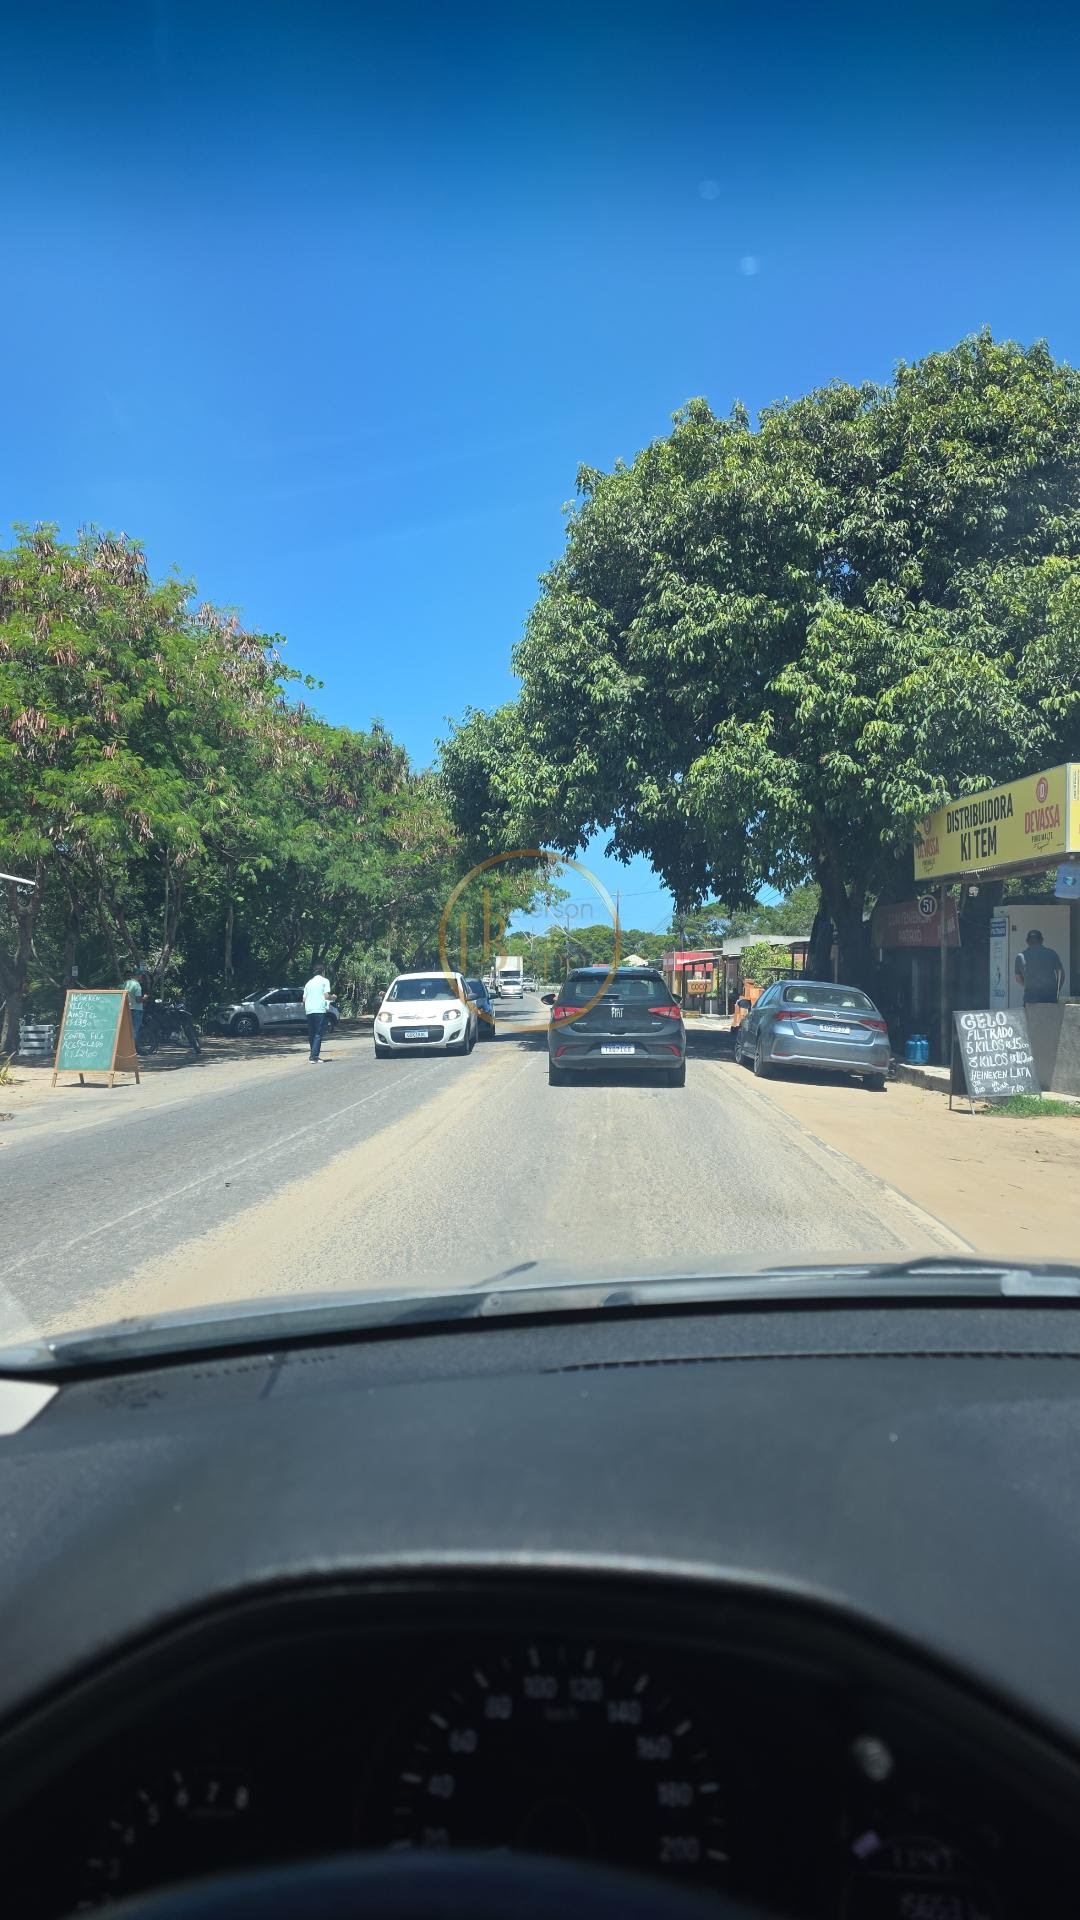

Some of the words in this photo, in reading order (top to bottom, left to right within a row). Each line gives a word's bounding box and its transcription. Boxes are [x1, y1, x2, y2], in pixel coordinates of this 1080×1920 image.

[946, 793, 1014, 834] DISTRIBUIDORA
[1024, 804, 1061, 835] DEVASSA
[961, 833, 971, 862] KI
[974, 825, 997, 859] TEM
[923, 900, 933, 913] 51
[611, 1007, 624, 1018] FIAT
[960, 1011, 1008, 1030] GELO
[967, 1026, 1014, 1041] FILTRADO
[967, 1041, 974, 1055] 5
[975, 1039, 1005, 1053] KILOS
[979, 1053, 1009, 1068] KILOS
[971, 1069, 1008, 1081] HEINEKEN
[1010, 1067, 1032, 1078] LATA
[660, 1835, 700, 1862] 200
